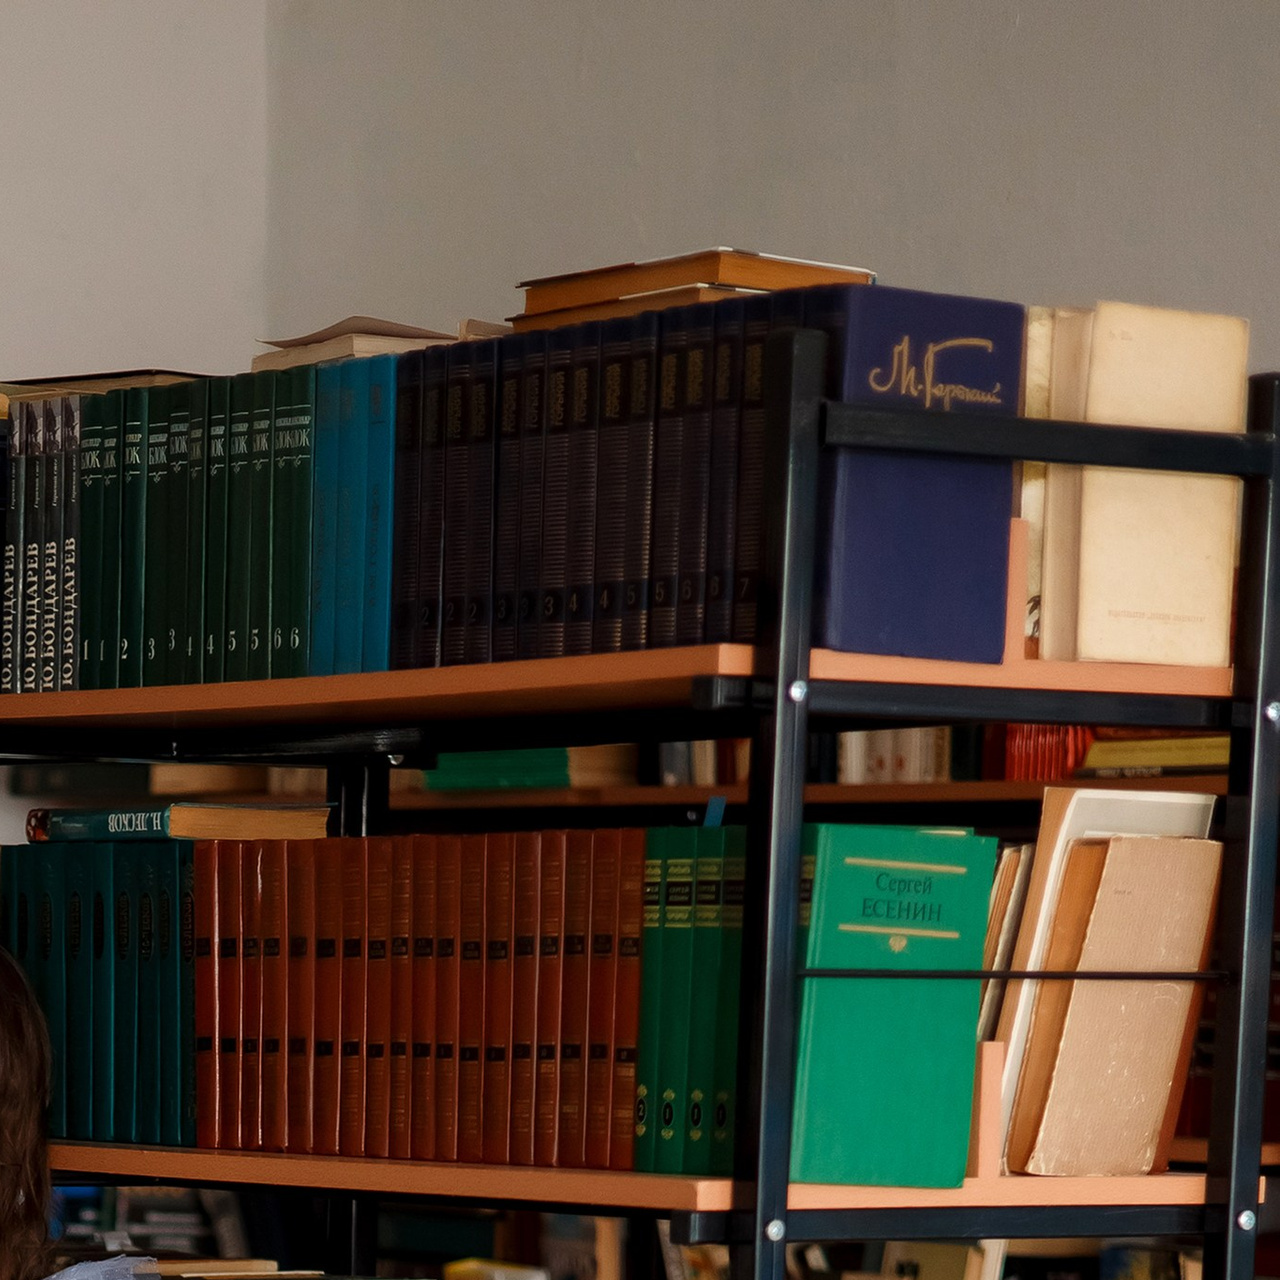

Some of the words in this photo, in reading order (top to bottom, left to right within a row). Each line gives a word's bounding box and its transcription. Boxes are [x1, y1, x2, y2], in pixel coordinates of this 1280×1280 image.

[2, 544, 17, 658] БОНДАРЕВ
[24, 542, 42, 658] БОНДАРЕВ
[42, 541, 60, 657] БОНДАРЕВ
[62, 537, 78, 654] БОНДАРЕВ
[544, 596, 554, 616] 3
[121, 638, 128, 660] 2
[148, 638, 156, 660] 3
[168, 628, 176, 650] 3
[206, 634, 214, 654] 4
[228, 630, 236, 651] 5
[251, 628, 259, 650] 5
[274, 628, 282, 649] 6
[290, 627, 299, 648] 6
[1, 663, 11, 689] Ю.
[23, 662, 35, 689] Ю.
[41, 661, 54, 688] Ю.
[61, 658, 72, 685] Ю.
[107, 812, 151, 833] ЛЕСКОВ
[875, 871, 932, 897] Сергей
[861, 898, 942, 922] ЕСЕНИН
